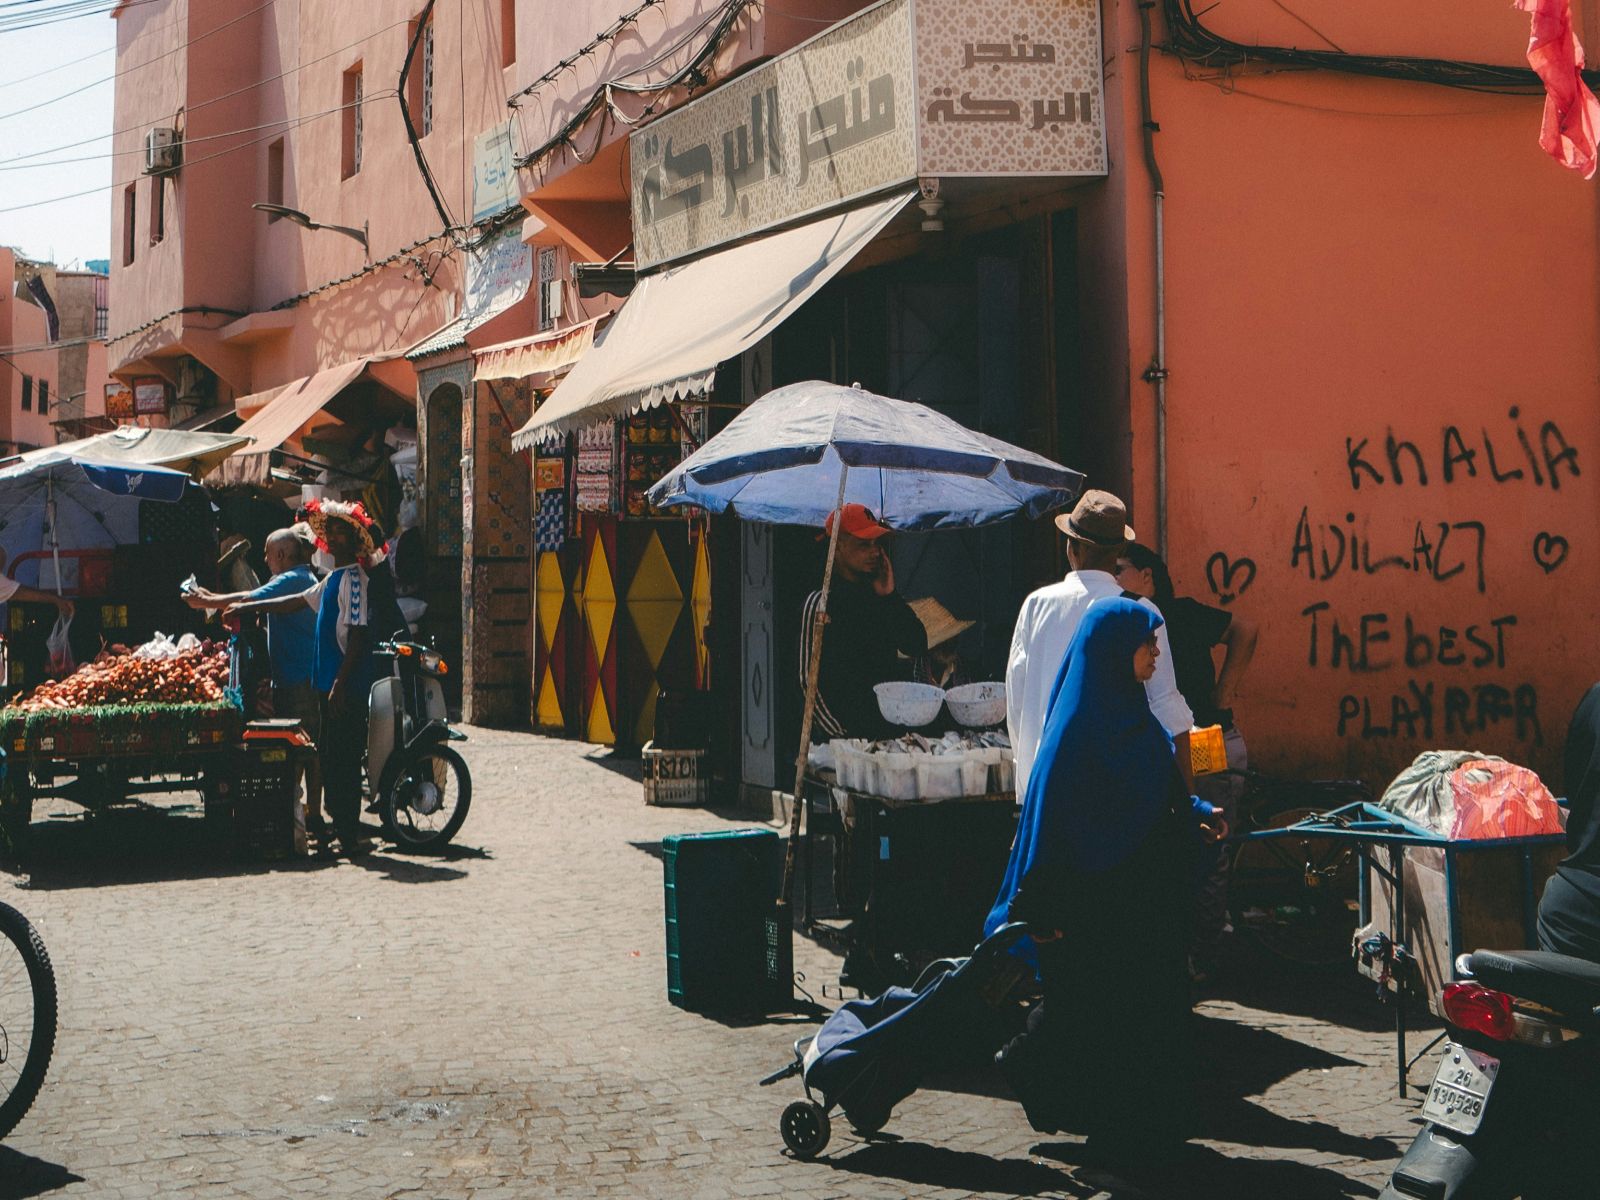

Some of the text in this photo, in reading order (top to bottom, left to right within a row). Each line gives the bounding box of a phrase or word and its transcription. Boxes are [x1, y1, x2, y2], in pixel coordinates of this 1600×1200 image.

[960, 34, 1056, 72] متجر
[927, 87, 1092, 133] البركة
[642, 55, 896, 226] متجر البركة
[1454, 1066, 1473, 1087] 26
[1433, 1085, 1482, 1117] 130529
